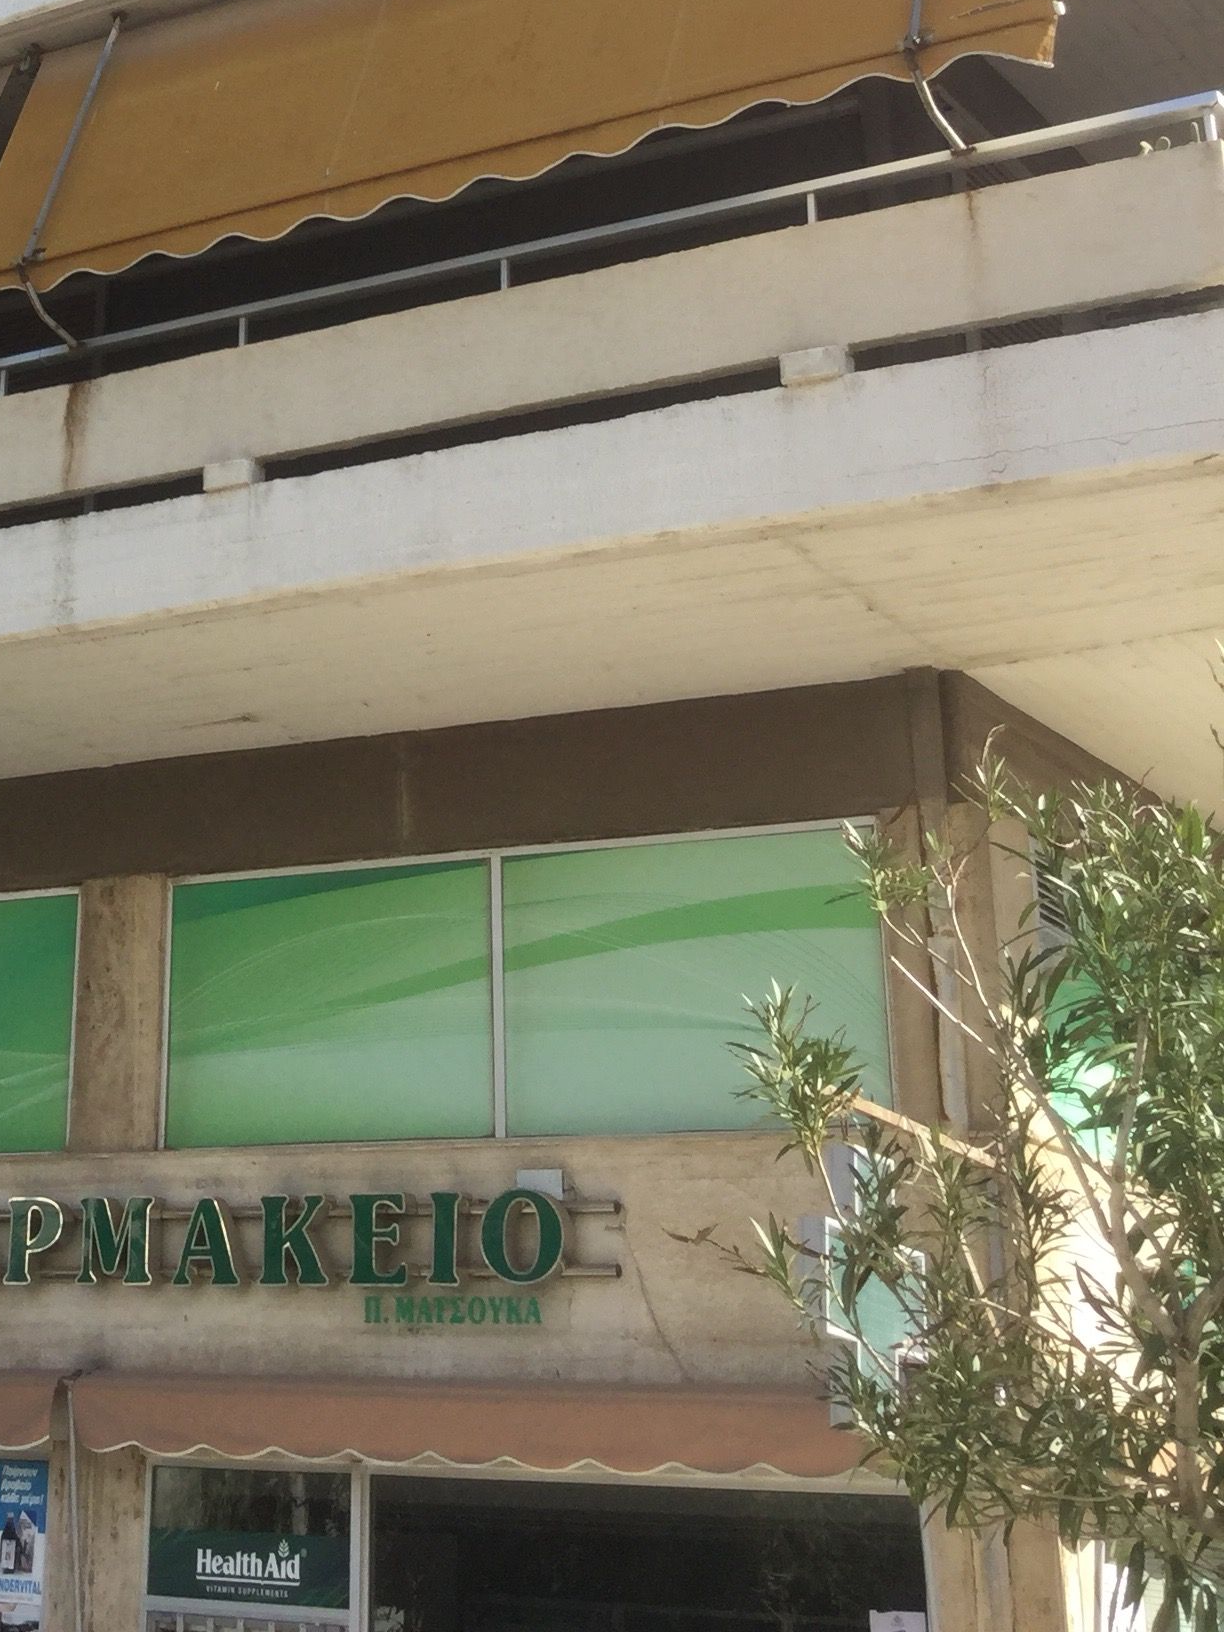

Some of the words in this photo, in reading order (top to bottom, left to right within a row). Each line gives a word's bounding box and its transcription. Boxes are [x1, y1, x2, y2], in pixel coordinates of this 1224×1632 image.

[395, 1296, 543, 1324] ΜΑΤΣΟΥΚΑ
[206, 1584, 235, 1594] VITAMIN
[237, 1586, 289, 1599] SUPPLEMENTS
